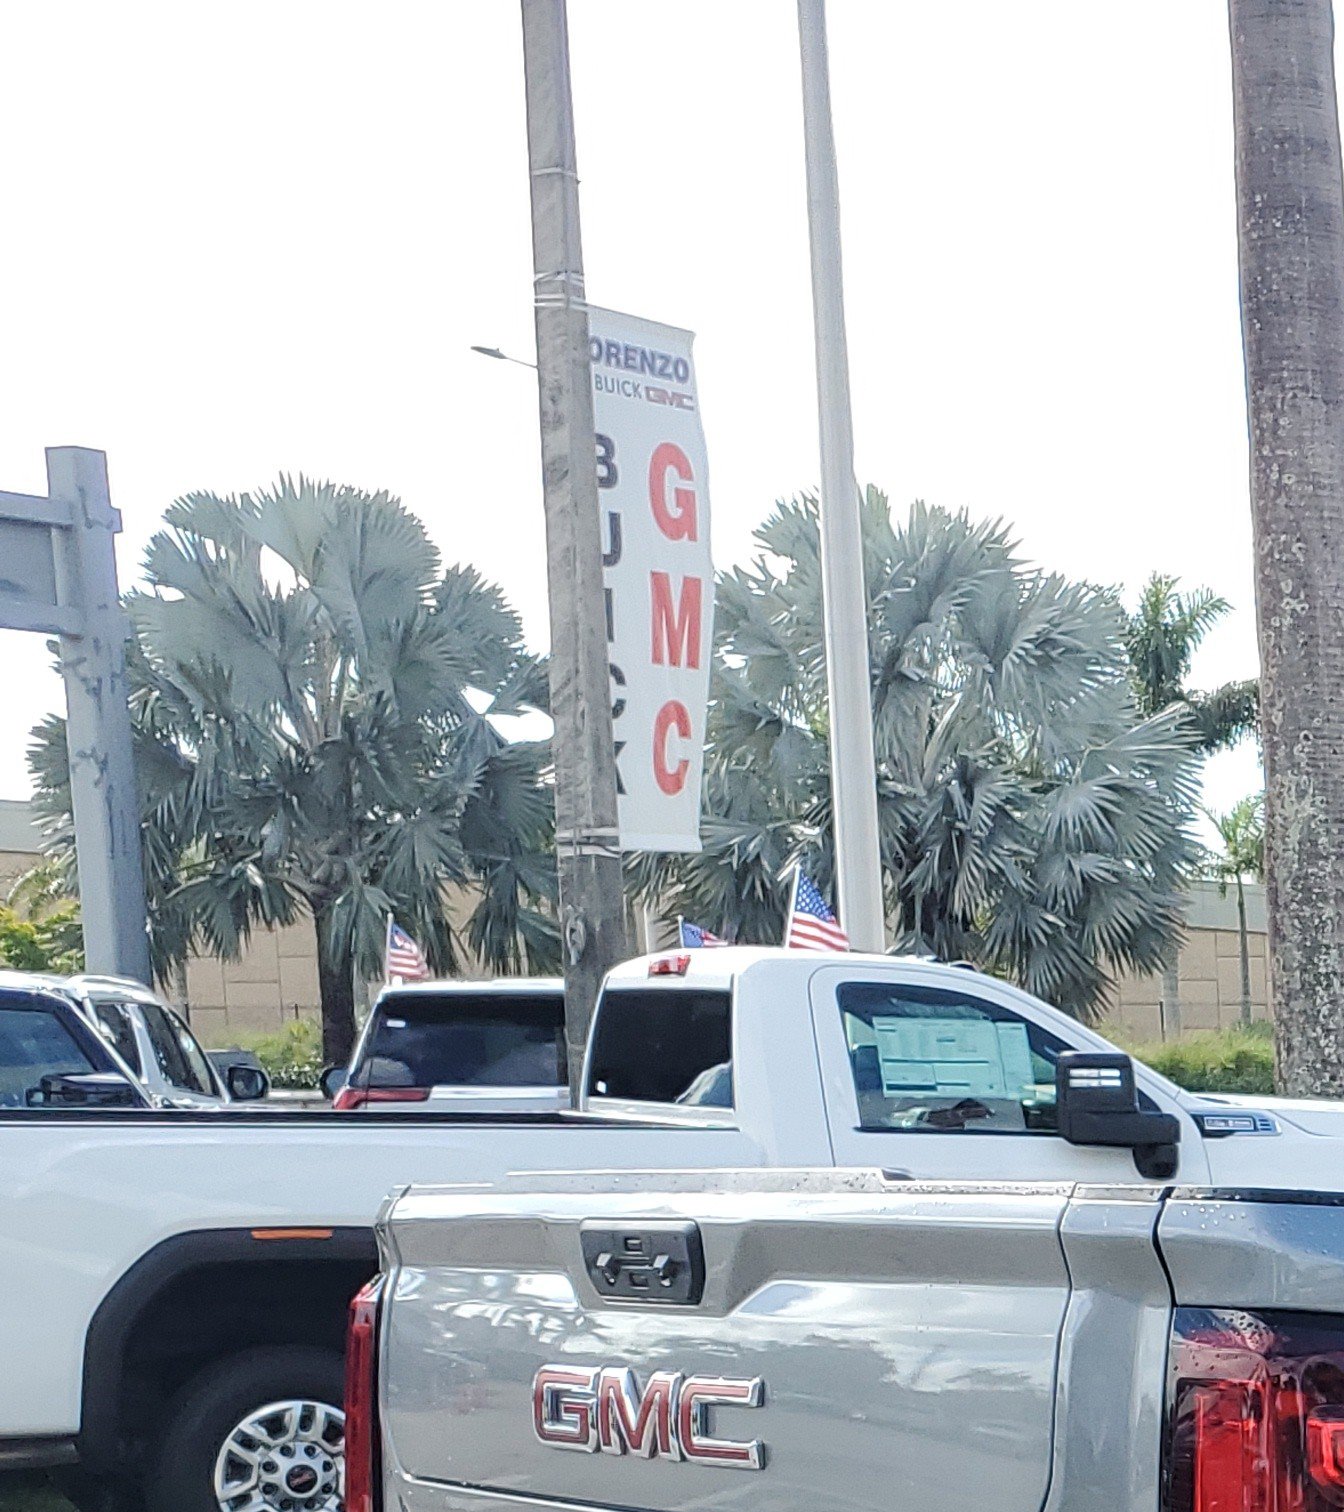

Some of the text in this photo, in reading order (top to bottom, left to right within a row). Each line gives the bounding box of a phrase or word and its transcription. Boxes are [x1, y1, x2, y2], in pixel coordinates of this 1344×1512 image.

[590, 337, 690, 384] ORENZO
[595, 374, 694, 411] BUICK GMC
[649, 442, 702, 796] GMC
[533, 1364, 766, 1470] GMC
